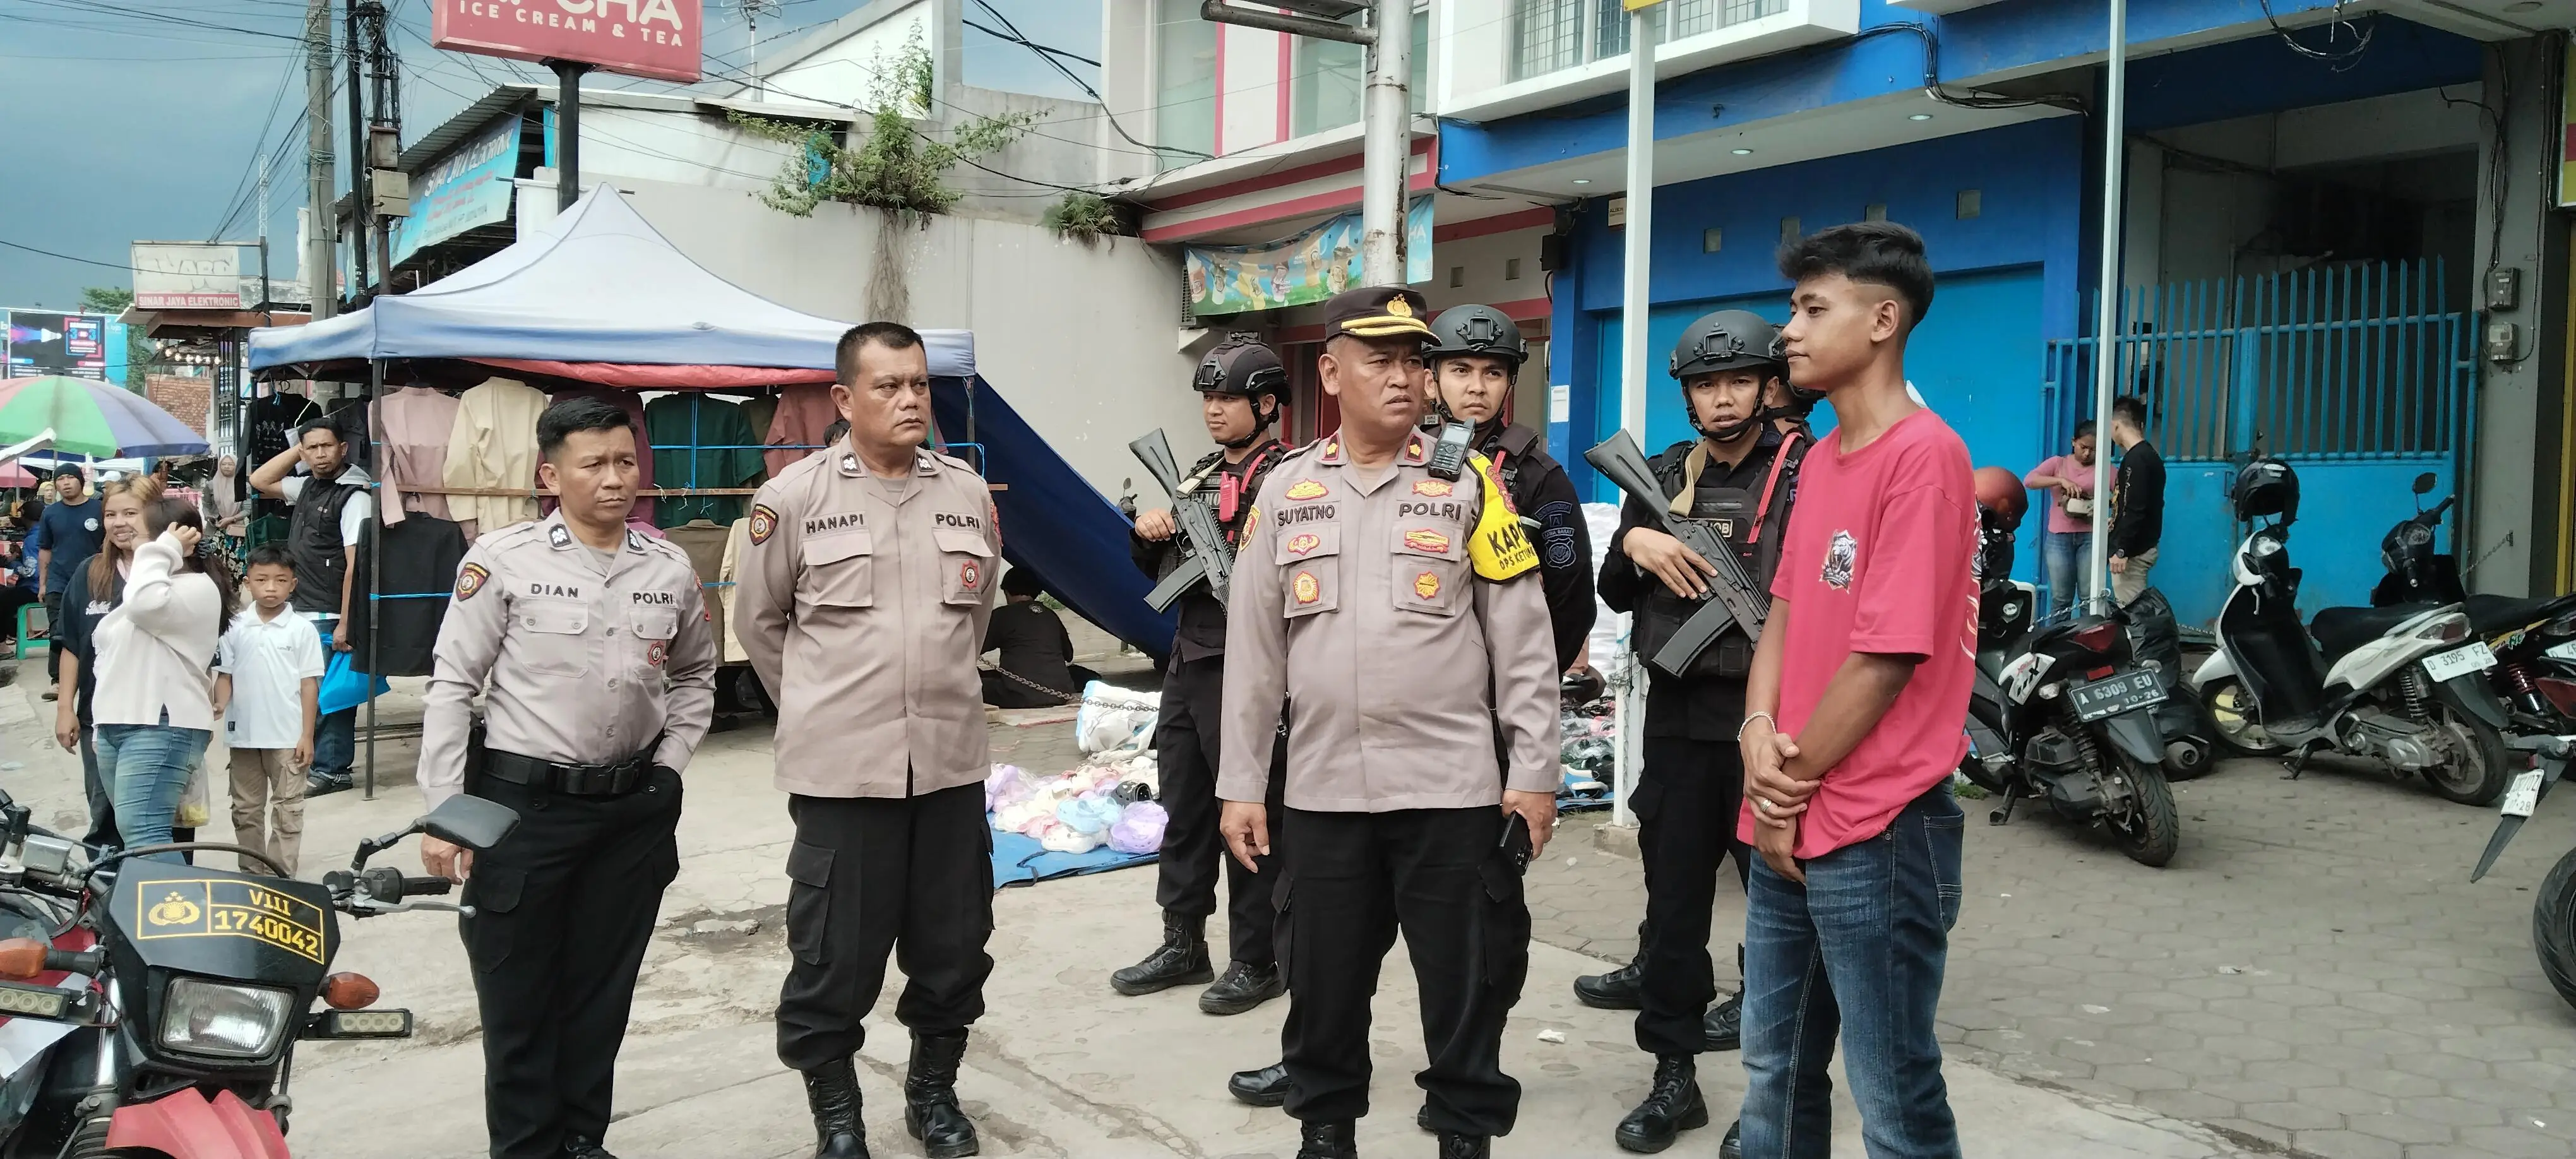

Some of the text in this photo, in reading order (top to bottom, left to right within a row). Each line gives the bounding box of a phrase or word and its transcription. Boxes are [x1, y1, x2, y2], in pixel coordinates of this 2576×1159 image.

[460, 0, 683, 47] ICE CREAM & TEA
[138, 296, 239, 307] SINAR JAYA ELEKTRONIC
[934, 513, 980, 529] POLRI
[1277, 504, 1335, 526] SUYATNO
[1399, 502, 1462, 520] POLRI
[806, 513, 864, 534] HANAPI
[1499, 556, 1515, 571] OPS
[530, 583, 578, 598] DIAN
[633, 592, 674, 605] POLRI
[2427, 644, 2488, 670] D 3195 FZ
[2080, 674, 2152, 705] A 6309 EU
[249, 889, 291, 917] VIII
[215, 910, 319, 956] 1740042
